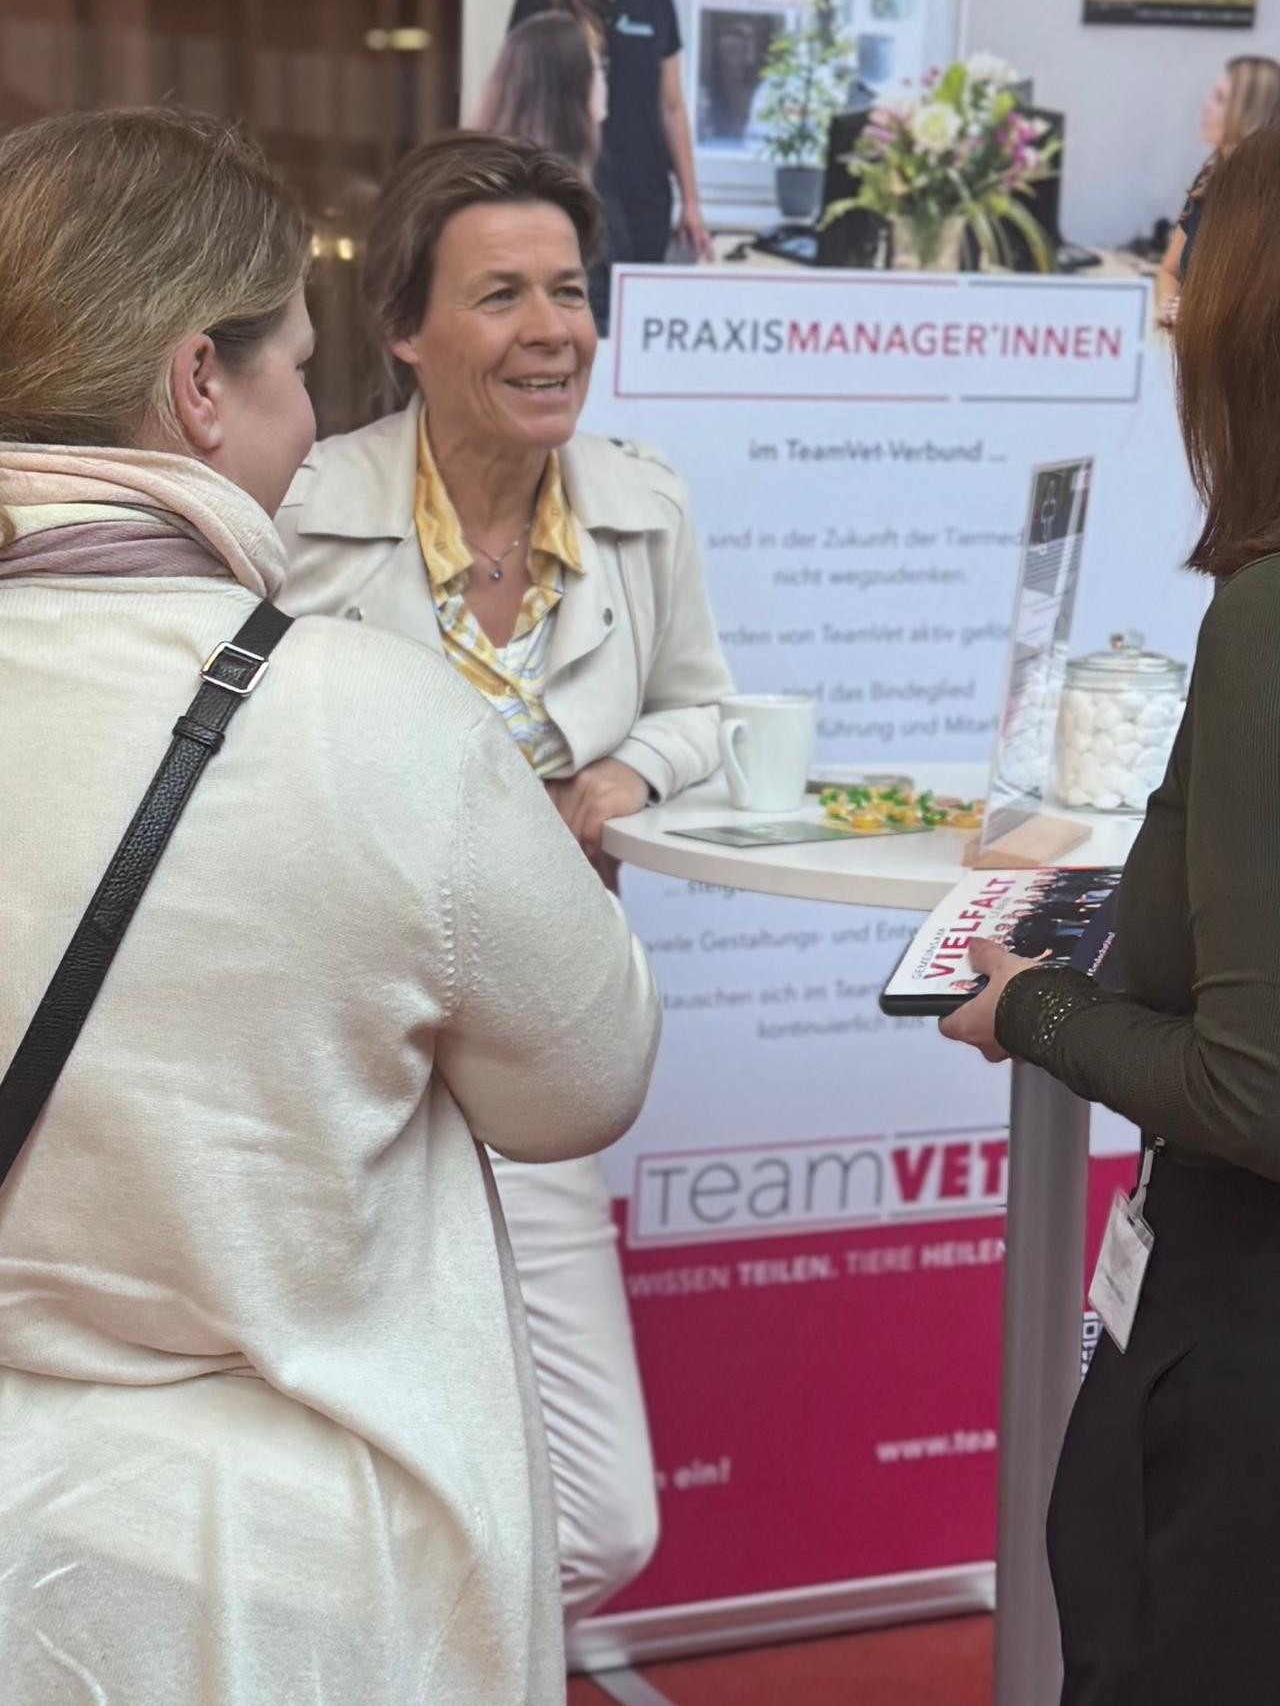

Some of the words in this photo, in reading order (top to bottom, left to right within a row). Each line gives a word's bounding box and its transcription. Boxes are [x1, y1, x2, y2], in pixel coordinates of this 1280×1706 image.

[749, 440, 778, 462] im
[787, 438, 983, 463] TeamVet-Verbund
[923, 877, 1017, 980] VIELFALT
[647, 1139, 1008, 1227] TeamVET
[628, 1264, 730, 1297] WISSEN
[845, 1246, 914, 1276] TIERE
